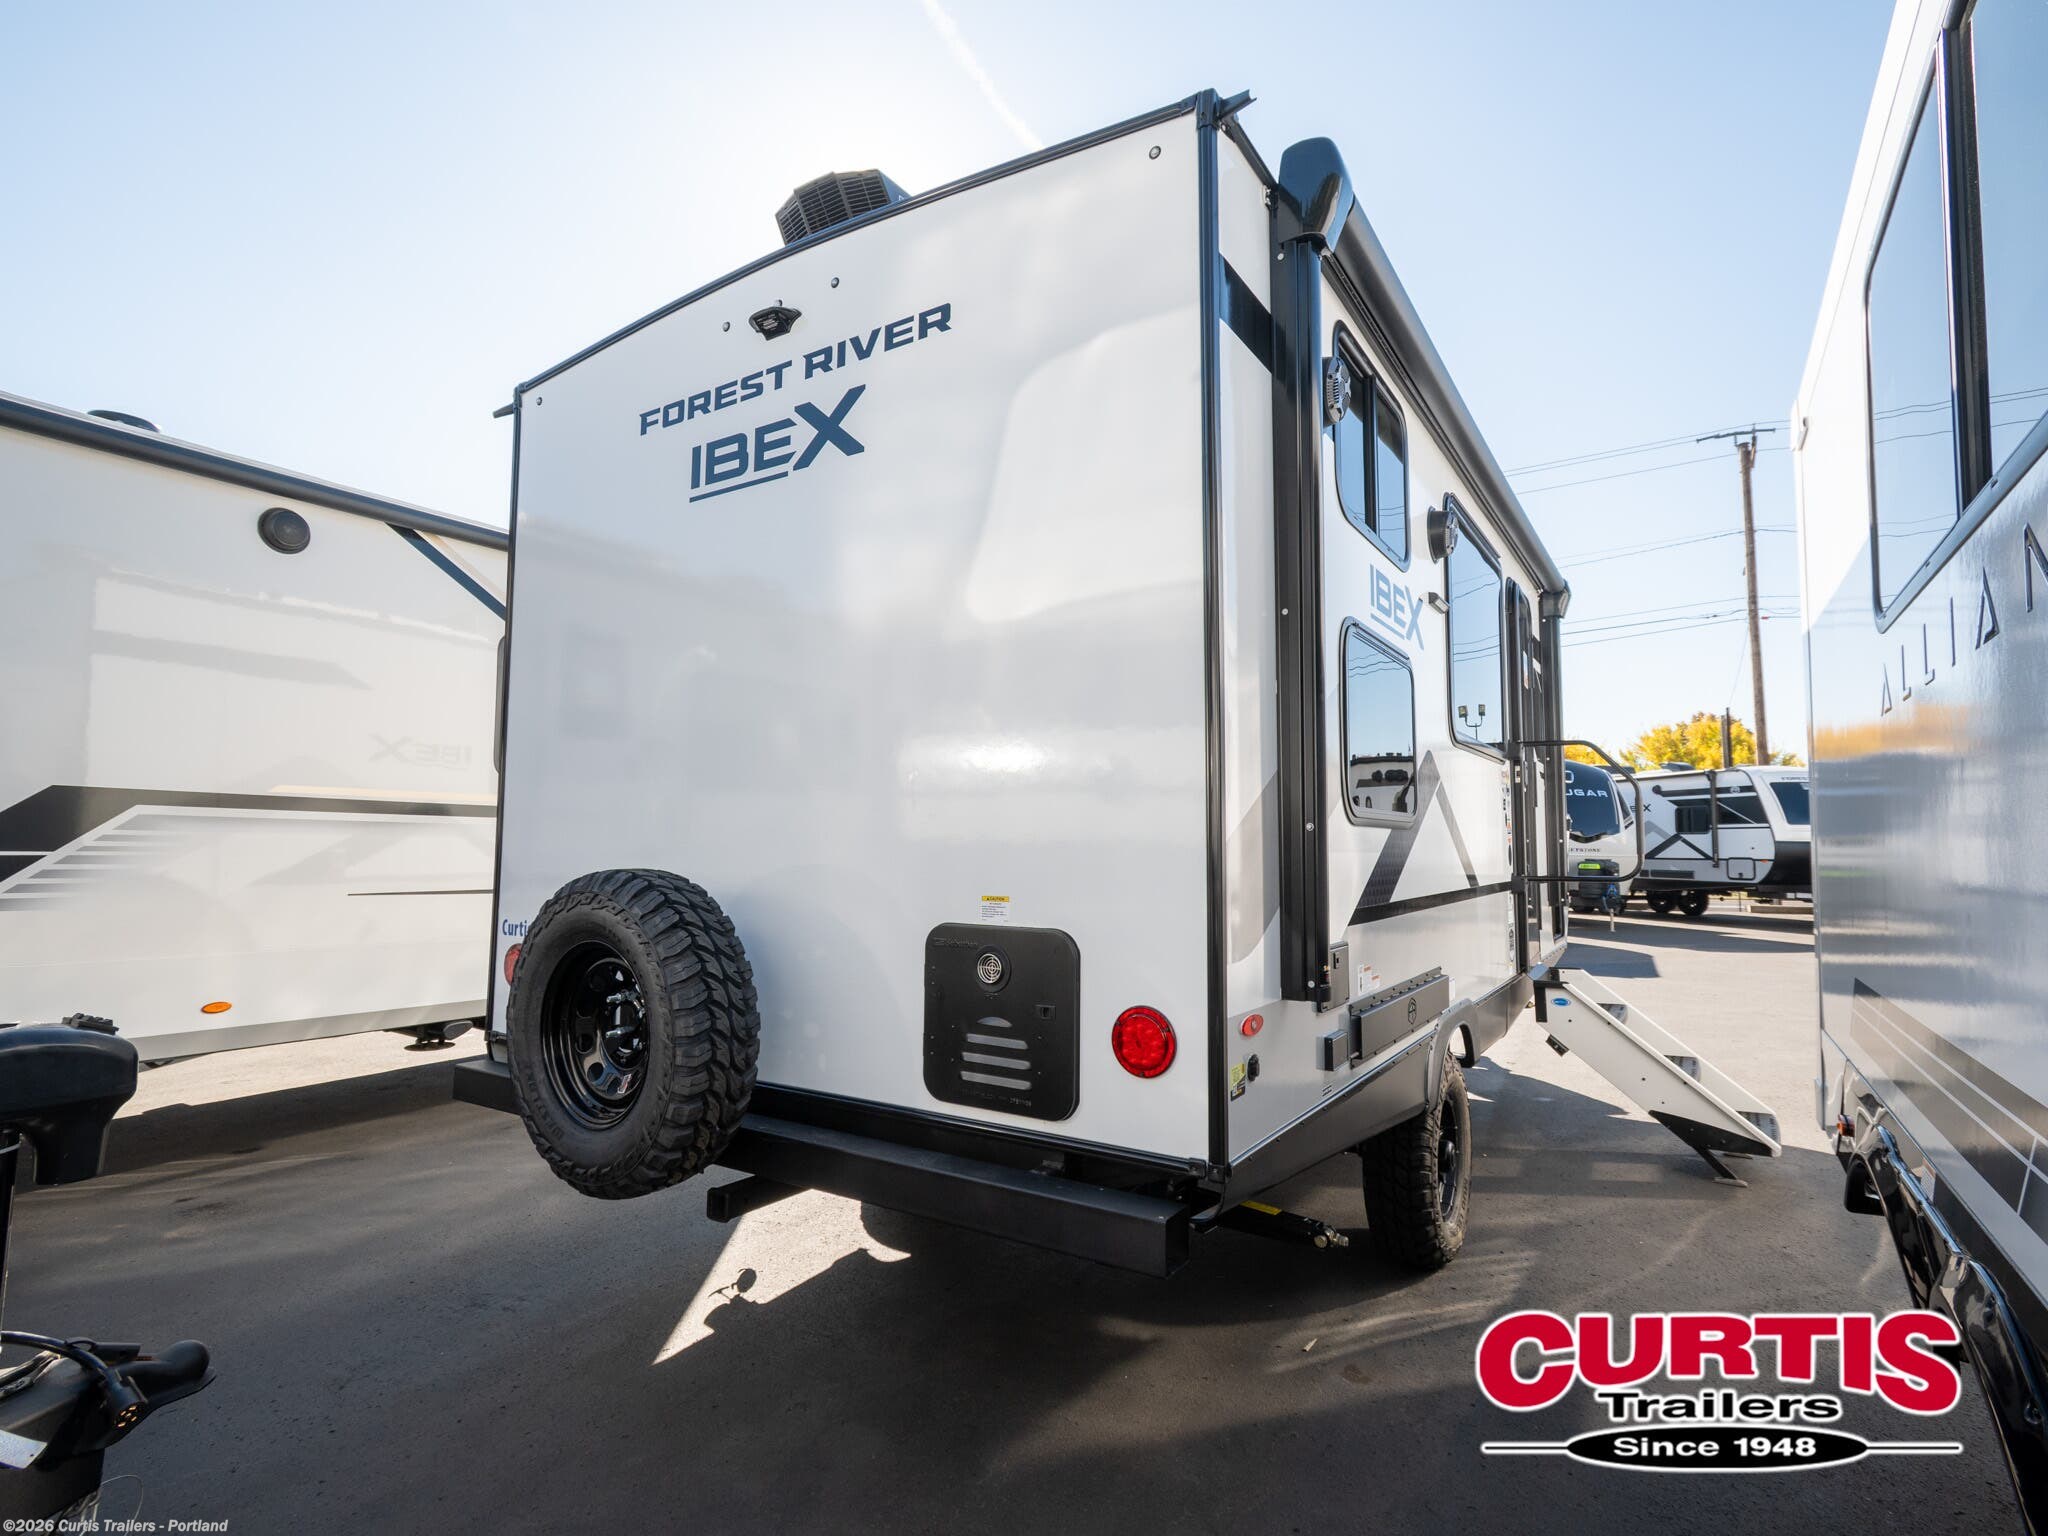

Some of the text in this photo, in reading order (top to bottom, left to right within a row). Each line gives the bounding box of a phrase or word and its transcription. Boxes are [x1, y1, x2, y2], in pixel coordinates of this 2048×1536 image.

[639, 302, 952, 436] FOREST RIVER
[690, 384, 866, 490] IBEX
[1370, 563, 1425, 651] IBEX
[1565, 788, 1609, 798] UGAR
[502, 918, 528, 937] Curti
